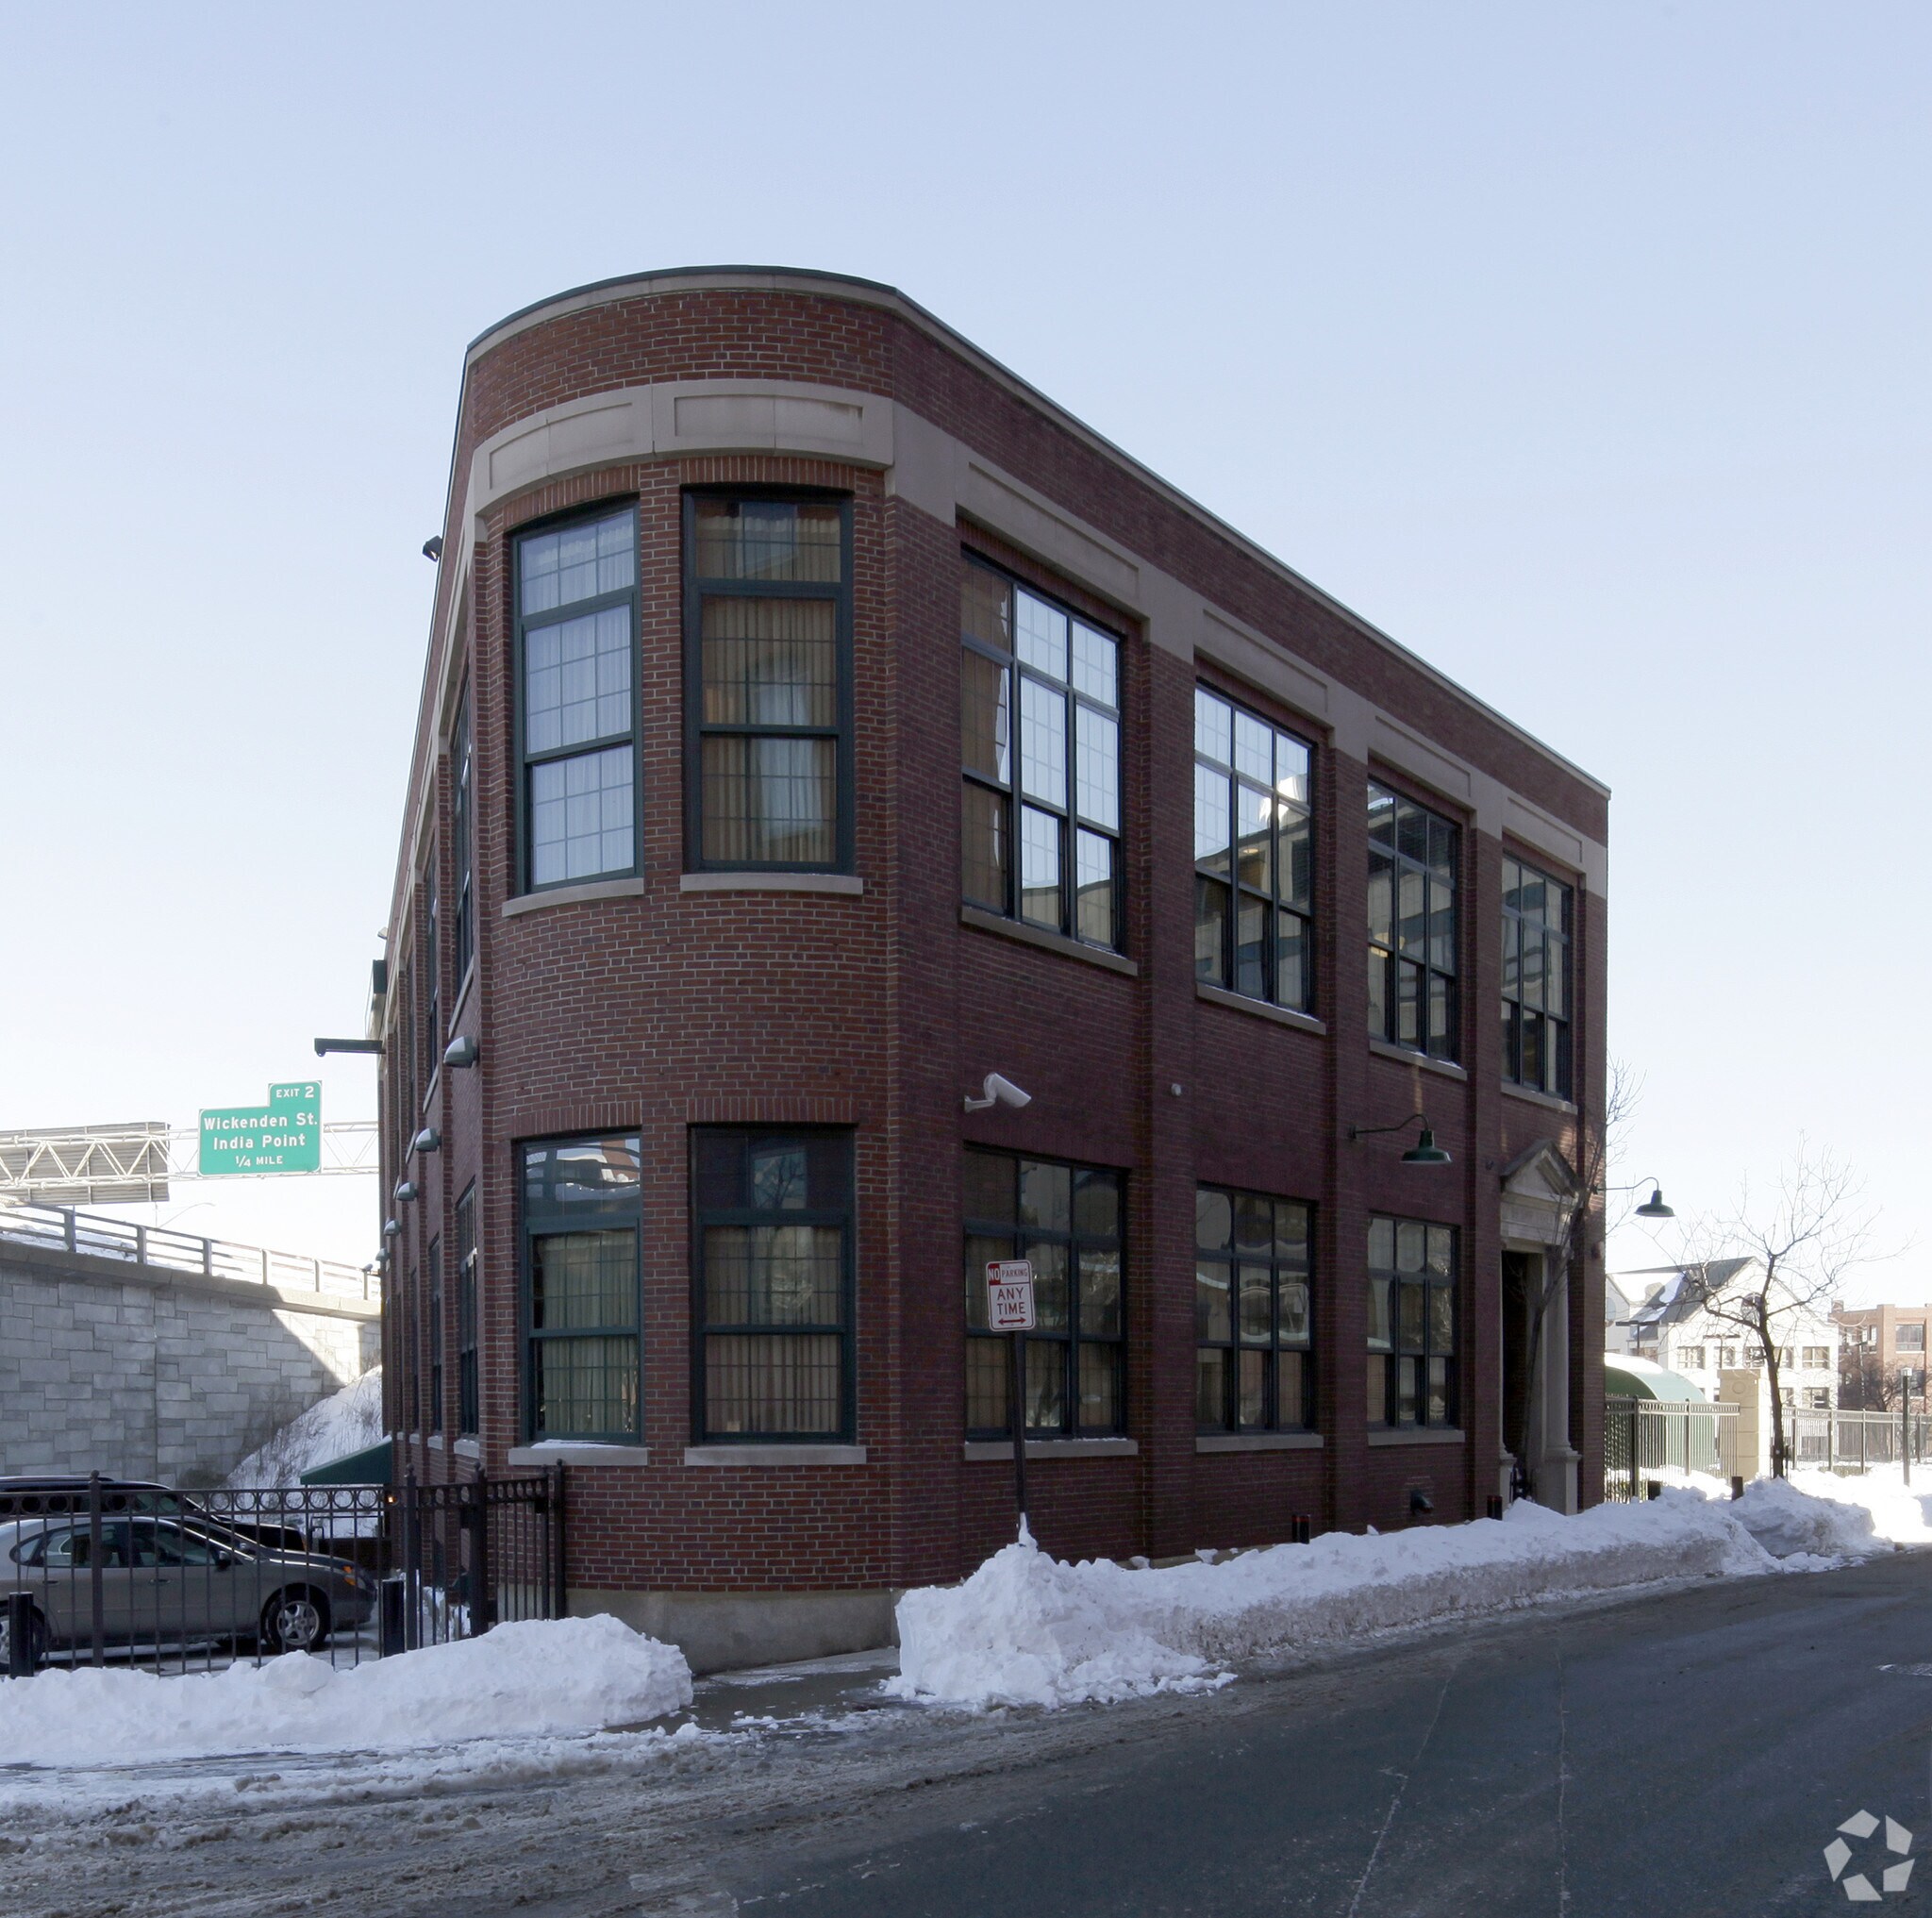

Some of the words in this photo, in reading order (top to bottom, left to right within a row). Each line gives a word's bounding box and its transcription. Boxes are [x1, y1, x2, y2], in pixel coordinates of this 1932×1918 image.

[276, 1088, 300, 1098] EXIT
[305, 1086, 314, 1098] 2
[204, 1115, 288, 1130] Wickenden
[296, 1112, 318, 1126] St.
[213, 1136, 254, 1150] India
[262, 1133, 306, 1148] Point
[256, 1156, 283, 1165] MILE
[988, 1268, 1000, 1281] NO
[1002, 1268, 1028, 1277] PARKING
[997, 1286, 1024, 1301] ANY
[996, 1302, 1026, 1315] TIME
